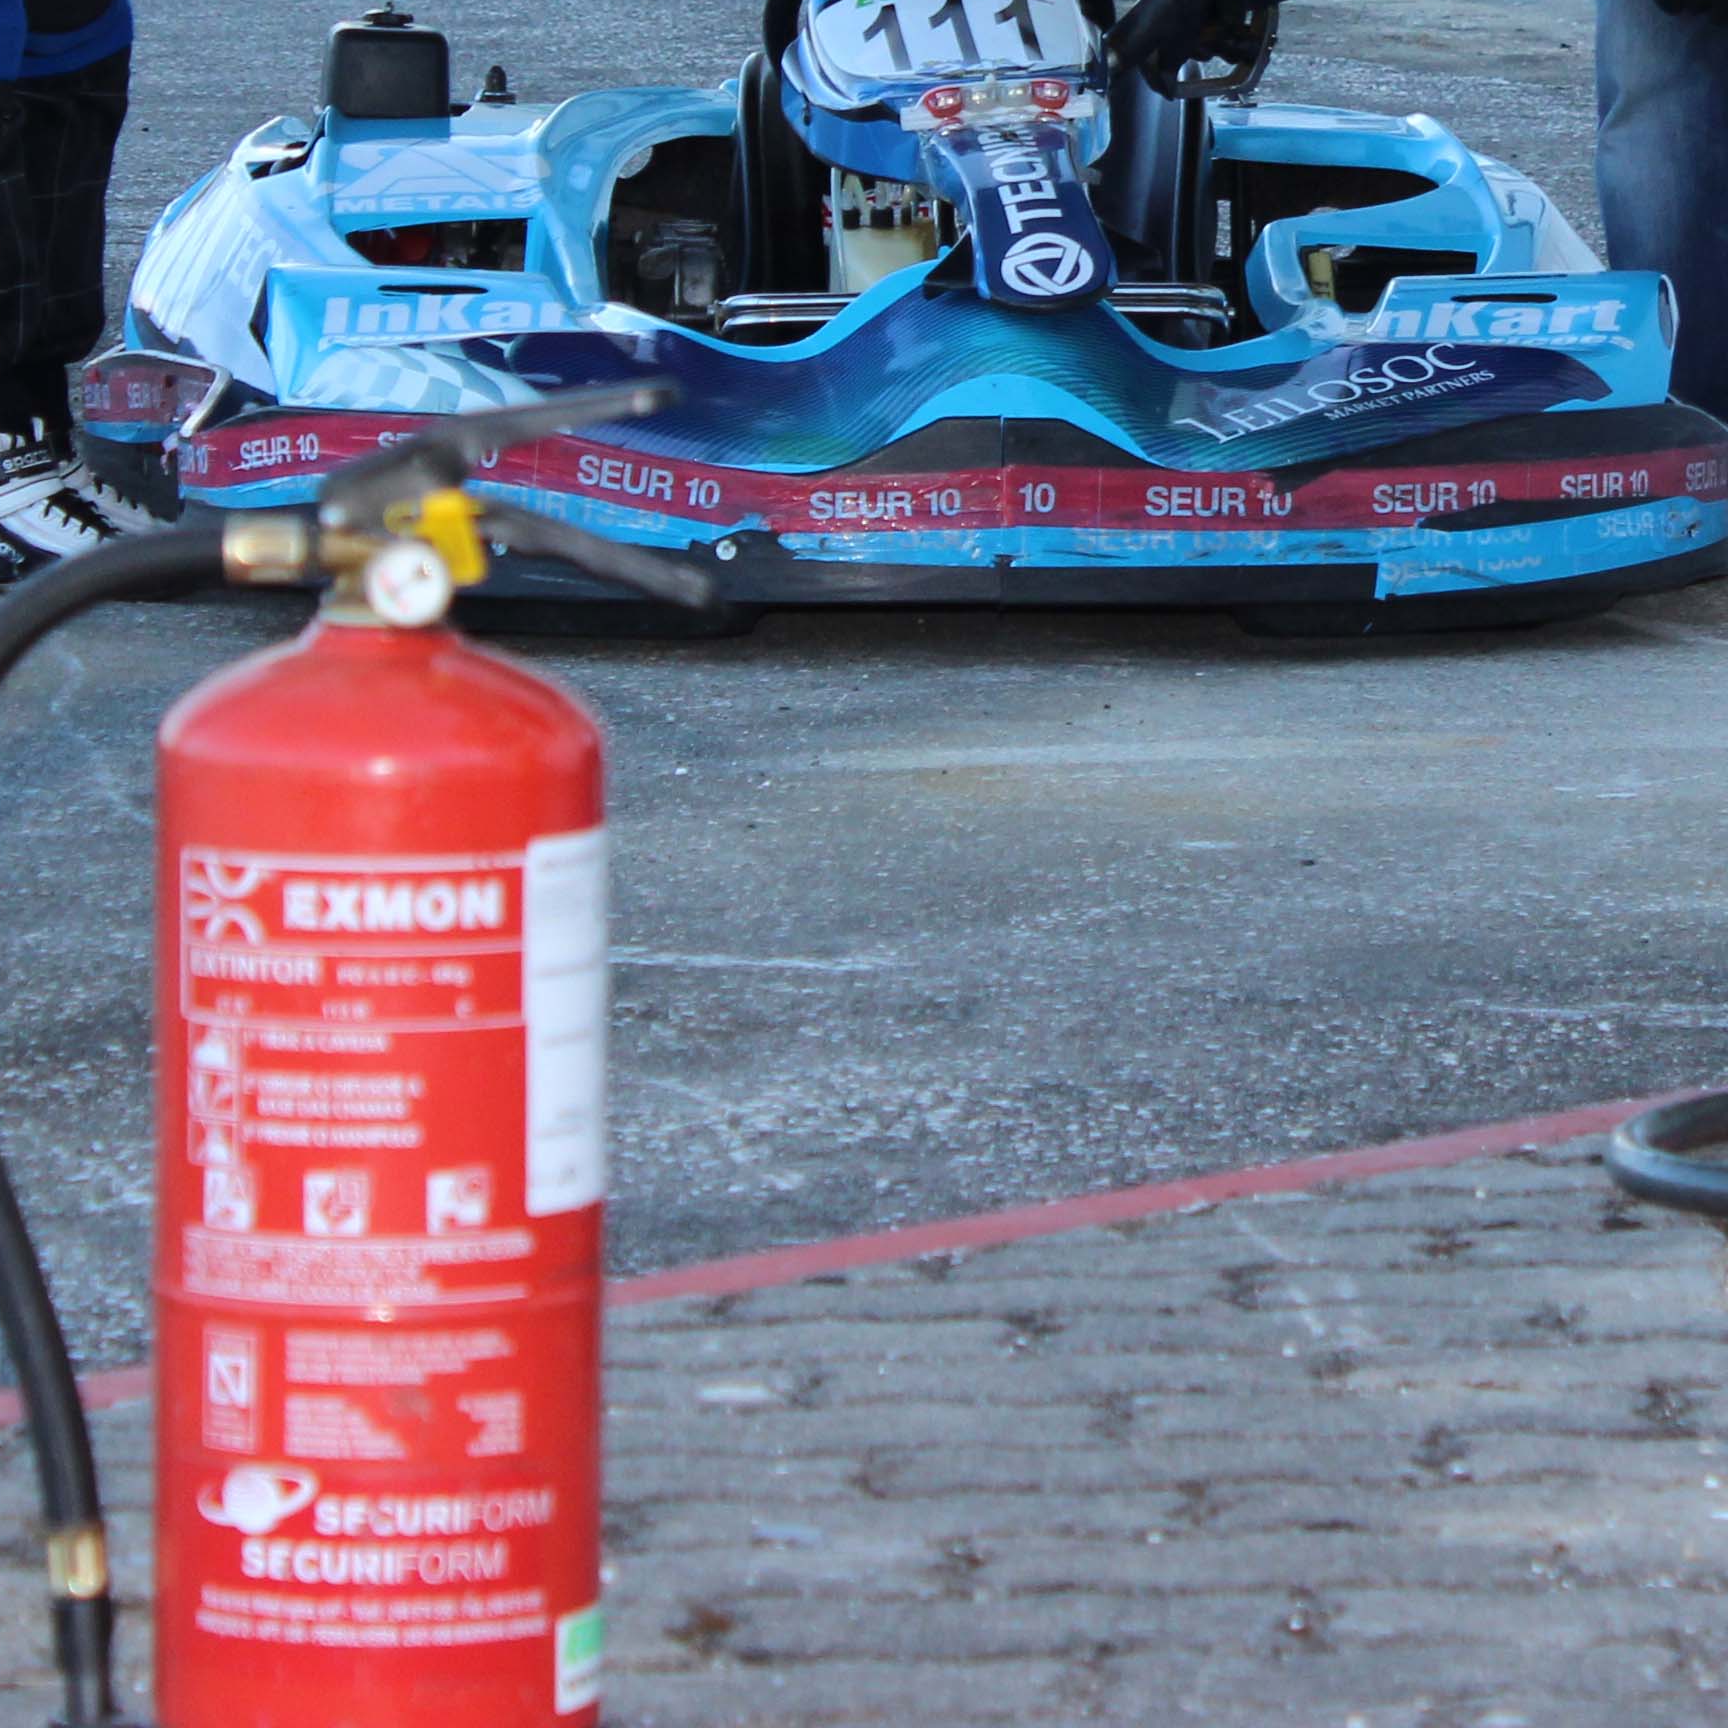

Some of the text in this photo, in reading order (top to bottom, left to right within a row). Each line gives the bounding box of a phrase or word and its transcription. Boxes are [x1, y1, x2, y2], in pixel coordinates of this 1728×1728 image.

[332, 187, 544, 214] METAIS
[1174, 342, 1478, 445] LEILOSOC
[1324, 368, 1497, 422] MARKET PARTNERS
[239, 432, 320, 470] SEUR 10
[576, 454, 674, 503] SEUR
[685, 477, 721, 510] 10
[1018, 482, 1056, 514] 10
[1372, 479, 1497, 515] SEUR 10
[1560, 468, 1649, 500] SEUR 10
[808, 487, 963, 520] SEUR 10
[1144, 485, 1293, 518] SEUR 10
[280, 879, 508, 932] EXMON
[312, 1486, 558, 1537] SECURIFORM
[240, 1537, 512, 1585] SECURIFORM
